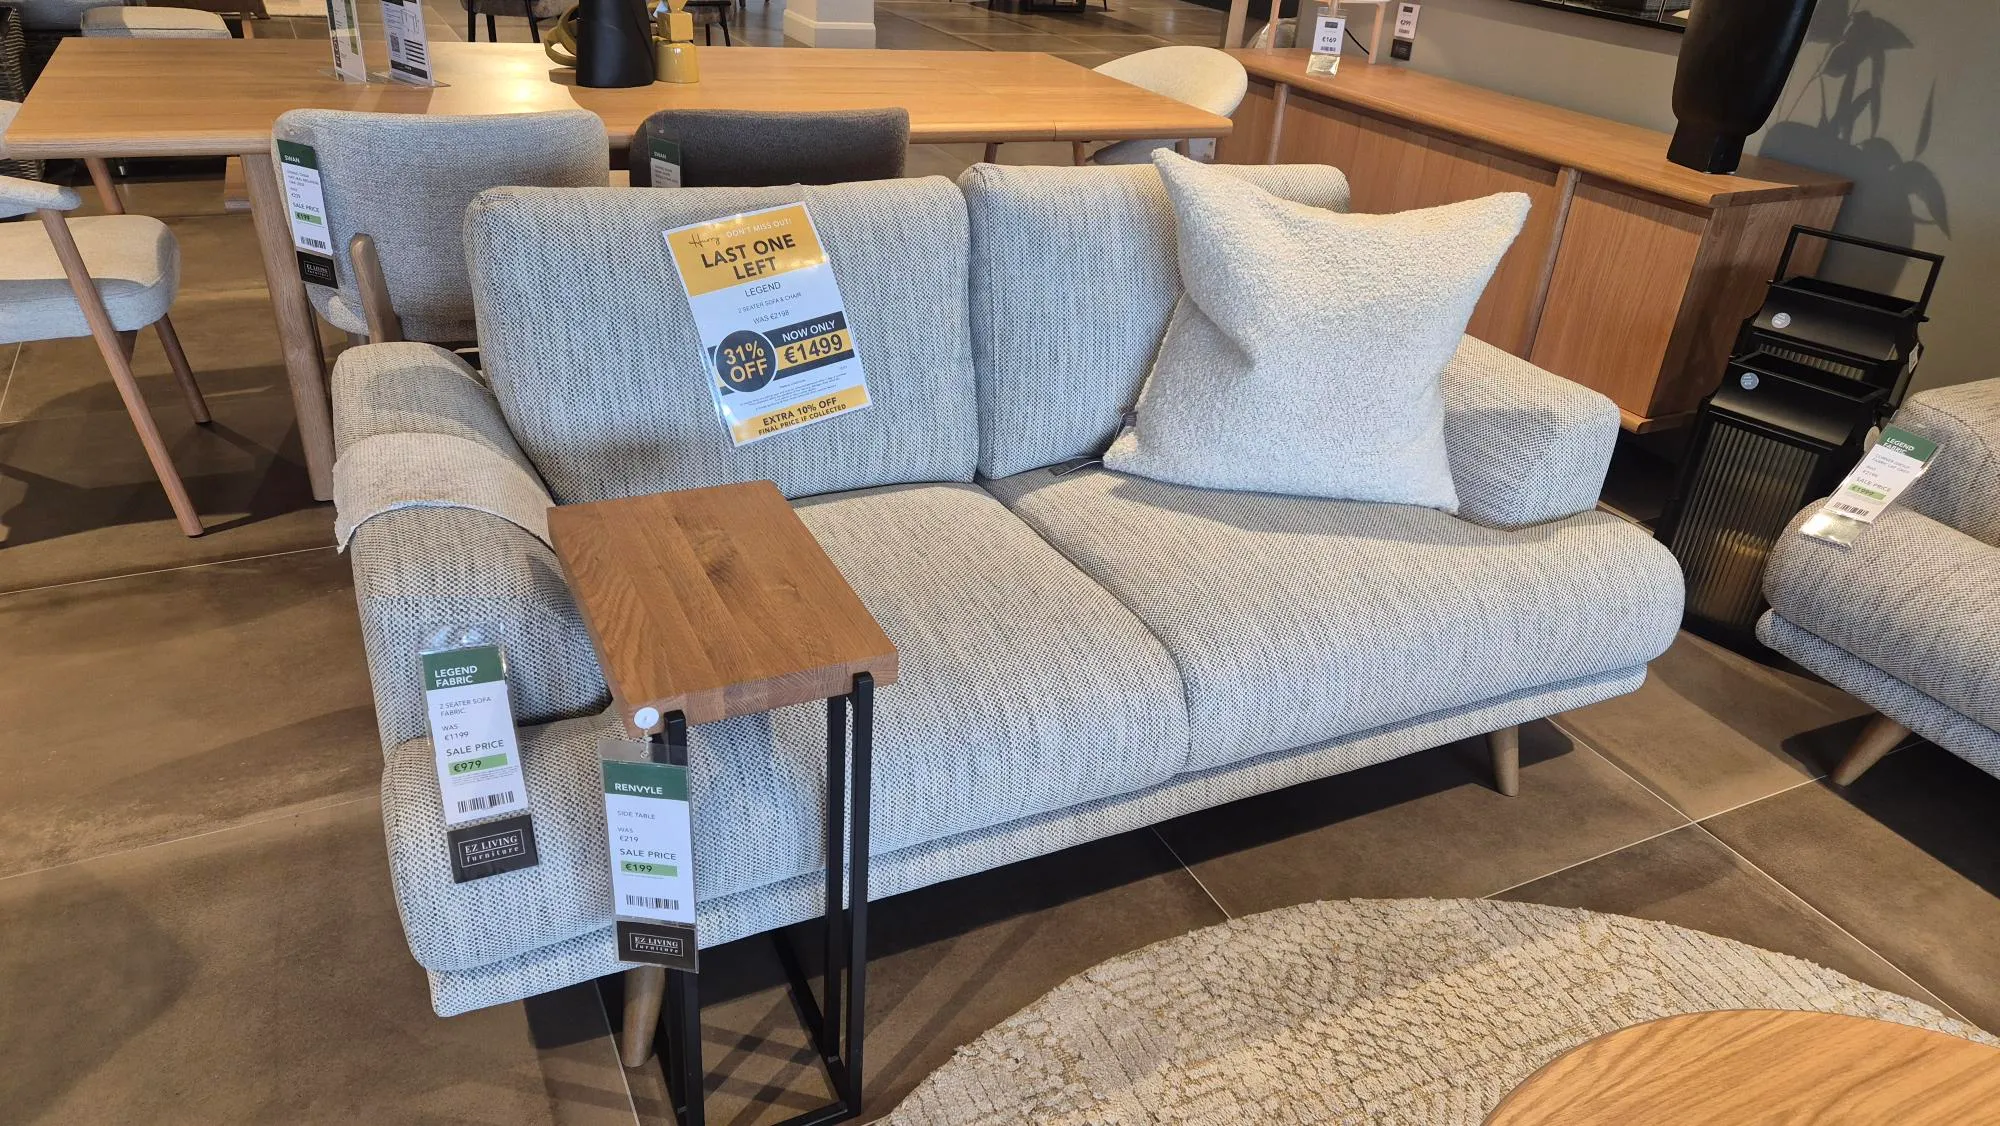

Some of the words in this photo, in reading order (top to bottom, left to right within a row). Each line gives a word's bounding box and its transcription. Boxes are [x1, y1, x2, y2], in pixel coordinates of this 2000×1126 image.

[293, 202, 305, 210] SALE
[305, 205, 320, 213] PRICE
[726, 225, 752, 238] DON'T
[753, 221, 773, 233] MISS
[773, 217, 793, 229] OUT!
[700, 244, 746, 269] LAST
[753, 233, 797, 256] ONE
[733, 256, 776, 280] LEFT
[744, 281, 781, 298] LEGEND
[742, 302, 764, 313] SEATER
[764, 298, 779, 308] SOFA
[784, 291, 802, 301] CHAIR
[753, 313, 769, 325] WAS
[769, 309, 790, 321] €2198
[782, 327, 808, 342] NOW
[810, 319, 836, 334] ONLY
[723, 340, 765, 365] 31%
[783, 333, 843, 365] €1499
[729, 357, 768, 383] OFF
[762, 412, 794, 426] EXTRA
[797, 403, 817, 416] 10%
[818, 397, 838, 409] OFF
[758, 425, 778, 436] FINAL
[780, 418, 799, 428] PRICE
[809, 403, 847, 420] COLLECTED
[1886, 436, 1915, 451] LEGEND
[1856, 477, 1872, 485] SALE
[1872, 483, 1892, 492] PRICE
[434, 665, 478, 678] LEGEND
[435, 675, 473, 688] FABRIC
[445, 699, 471, 709] SEATER
[472, 696, 492, 704] SOFA
[440, 707, 464, 717] FABRIC
[444, 731, 469, 741] €1199
[446, 745, 472, 757] SALE
[475, 739, 504, 751] PRICE
[453, 759, 482, 773] €979
[614, 782, 663, 795] RENVYLE
[617, 810, 633, 818] SIDE
[635, 811, 656, 820] TABLE
[617, 826, 634, 834] WAS
[465, 844, 478, 854] EZ
[481, 835, 518, 850] LIVING
[619, 835, 639, 843] €219
[466, 846, 519, 863] furniture
[619, 848, 645, 858] SALE
[647, 850, 677, 861] PRICE
[625, 863, 653, 873] €199
[635, 943, 679, 954] furniture
[648, 938, 678, 947] LIVING
